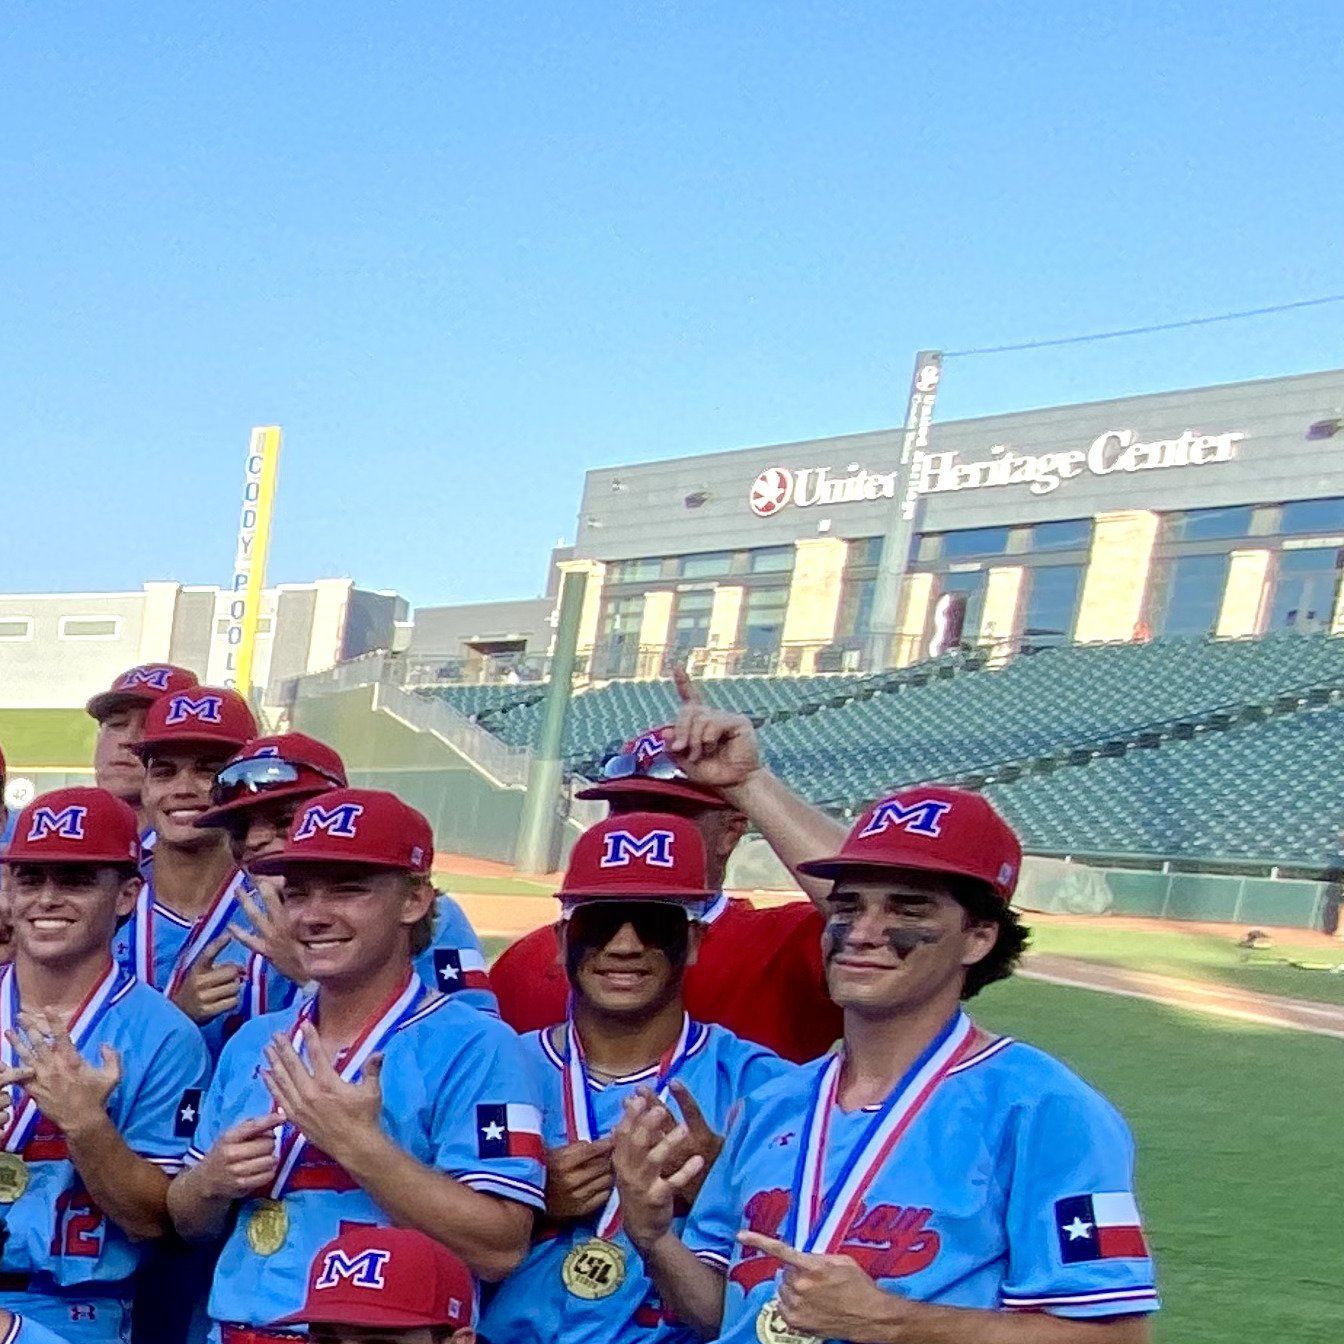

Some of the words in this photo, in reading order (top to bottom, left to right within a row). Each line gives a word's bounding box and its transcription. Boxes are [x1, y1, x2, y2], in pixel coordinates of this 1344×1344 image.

[918, 444, 1085, 494] Heritage
[1088, 429, 1248, 475] Center
[241, 455, 263, 554] CODY
[121, 667, 173, 691] M
[166, 695, 223, 725] M
[27, 805, 88, 842] M
[292, 802, 364, 842] M
[858, 800, 952, 838] M
[600, 830, 675, 868] M
[49, 1190, 107, 1257] 12
[315, 1249, 391, 1290] M
